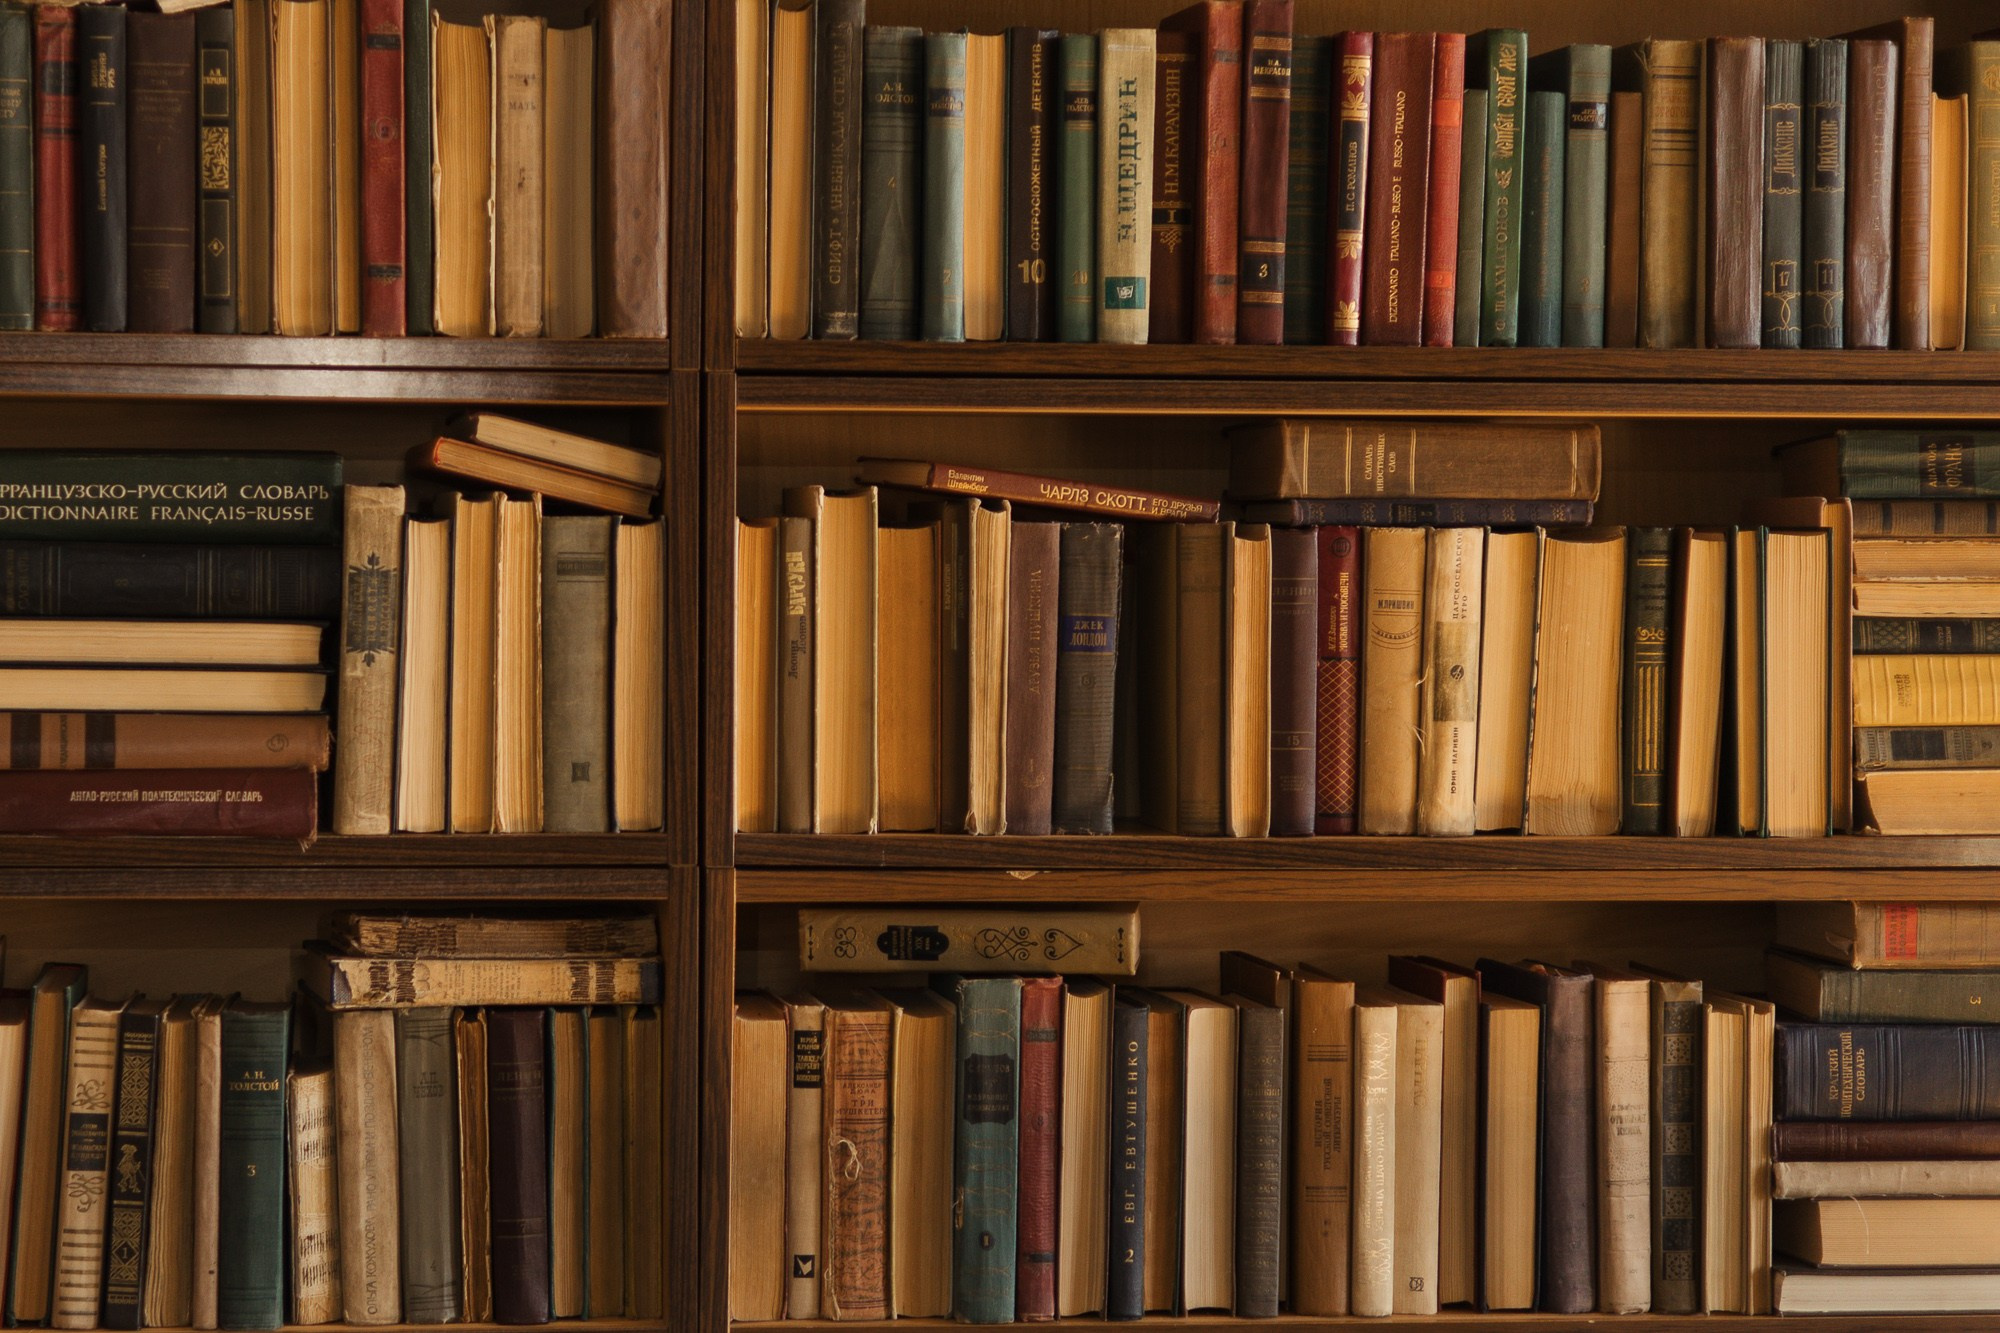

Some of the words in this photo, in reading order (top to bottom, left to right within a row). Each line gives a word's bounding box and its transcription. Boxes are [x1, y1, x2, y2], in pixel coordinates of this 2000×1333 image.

[1031, 43, 1043, 112] ДЕТЕКТИВ
[1117, 76, 1142, 215] ЩЕДРИН
[1346, 141, 1358, 190] РОМАНОВ
[1029, 124, 1041, 251] ОСТРОСЮЖЕТНЫЙ
[829, 228, 842, 285] СВИФТ
[1017, 258, 1046, 284] 10
[1258, 263, 1268, 278] 3
[1779, 271, 1790, 287] 17
[1822, 269, 1834, 285] 11
[1388, 268, 1399, 322] DIZIONARIO
[1364, 443, 1374, 480] СЛОВАРЬ
[1376, 433, 1386, 492] ИНОСТРАННЫХ
[1388, 451, 1397, 473] СЛОВ
[946, 478, 989, 494] Штейнберг
[948, 469, 986, 484] Валентин
[239, 484, 331, 501] СЛОВАРЬ
[1039, 482, 1089, 504] ЧАРЛЗ
[1095, 491, 1148, 512] СКОТТ.
[1152, 497, 1169, 508] ЕГО
[1170, 499, 1204, 514] ДРУЗЬЯ
[151, 506, 315, 525] FRANÇAIS-RUSSE
[1160, 507, 1188, 519] ВРАГИ
[785, 551, 806, 616] БАРСУКИ
[1460, 595, 1468, 620] УТРО
[1073, 620, 1104, 631] ДЖЕК
[1068, 632, 1108, 647] ЛОНДОН
[1287, 735, 1300, 746] 15
[1451, 727, 1459, 764] НАГИБИН
[70, 789, 139, 802] АНГЛО-РУССКИЙ
[1969, 995, 1982, 1005] 3
[229, 1078, 280, 1091] ТОЛСТОЙ
[1827, 1048, 1838, 1100] КРАТКИЙ
[1840, 1031, 1853, 1117] ПОЛИТЕХНИЧЕСКИЙ
[1856, 1047, 1866, 1101] СЛОВАРЬ
[850, 1099, 874, 1107] ТРИ
[1125, 1040, 1138, 1170] ЕВТУШЕНКО
[1314, 1099, 1322, 1148] ИСТОРИЯ
[247, 1164, 256, 1177] 3
[1124, 1183, 1135, 1224] ЕВГ.
[122, 1247, 128, 1259] 1
[1124, 1249, 1134, 1264] 2
[366, 1280, 378, 1315] ОЛЬГА
